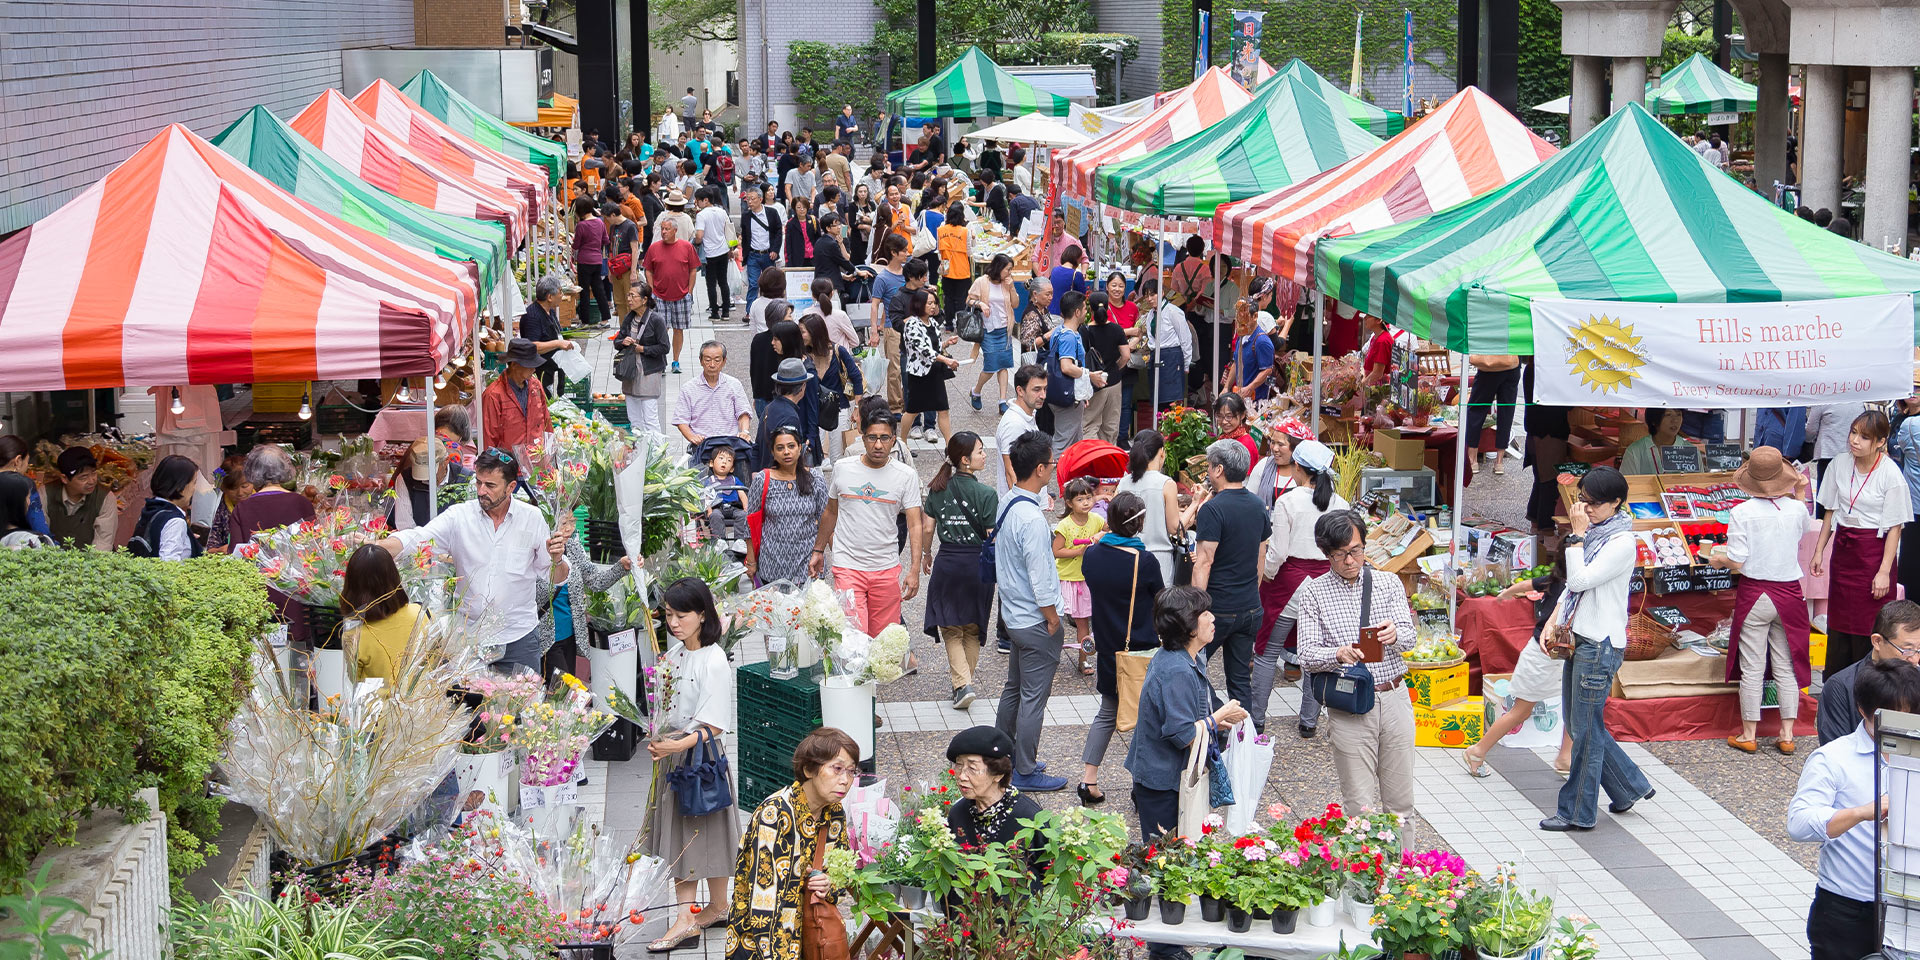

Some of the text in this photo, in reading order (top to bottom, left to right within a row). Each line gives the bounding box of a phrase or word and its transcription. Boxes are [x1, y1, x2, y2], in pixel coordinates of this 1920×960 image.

[1696, 315, 1843, 344] Hills marche
[1718, 350, 1827, 371] in ARK Hills
[1672, 381, 1712, 400] Every
[1715, 383, 1782, 399] Saturday
[1667, 580, 1691, 592] ¥700
[1415, 718, 1440, 728] みかん
